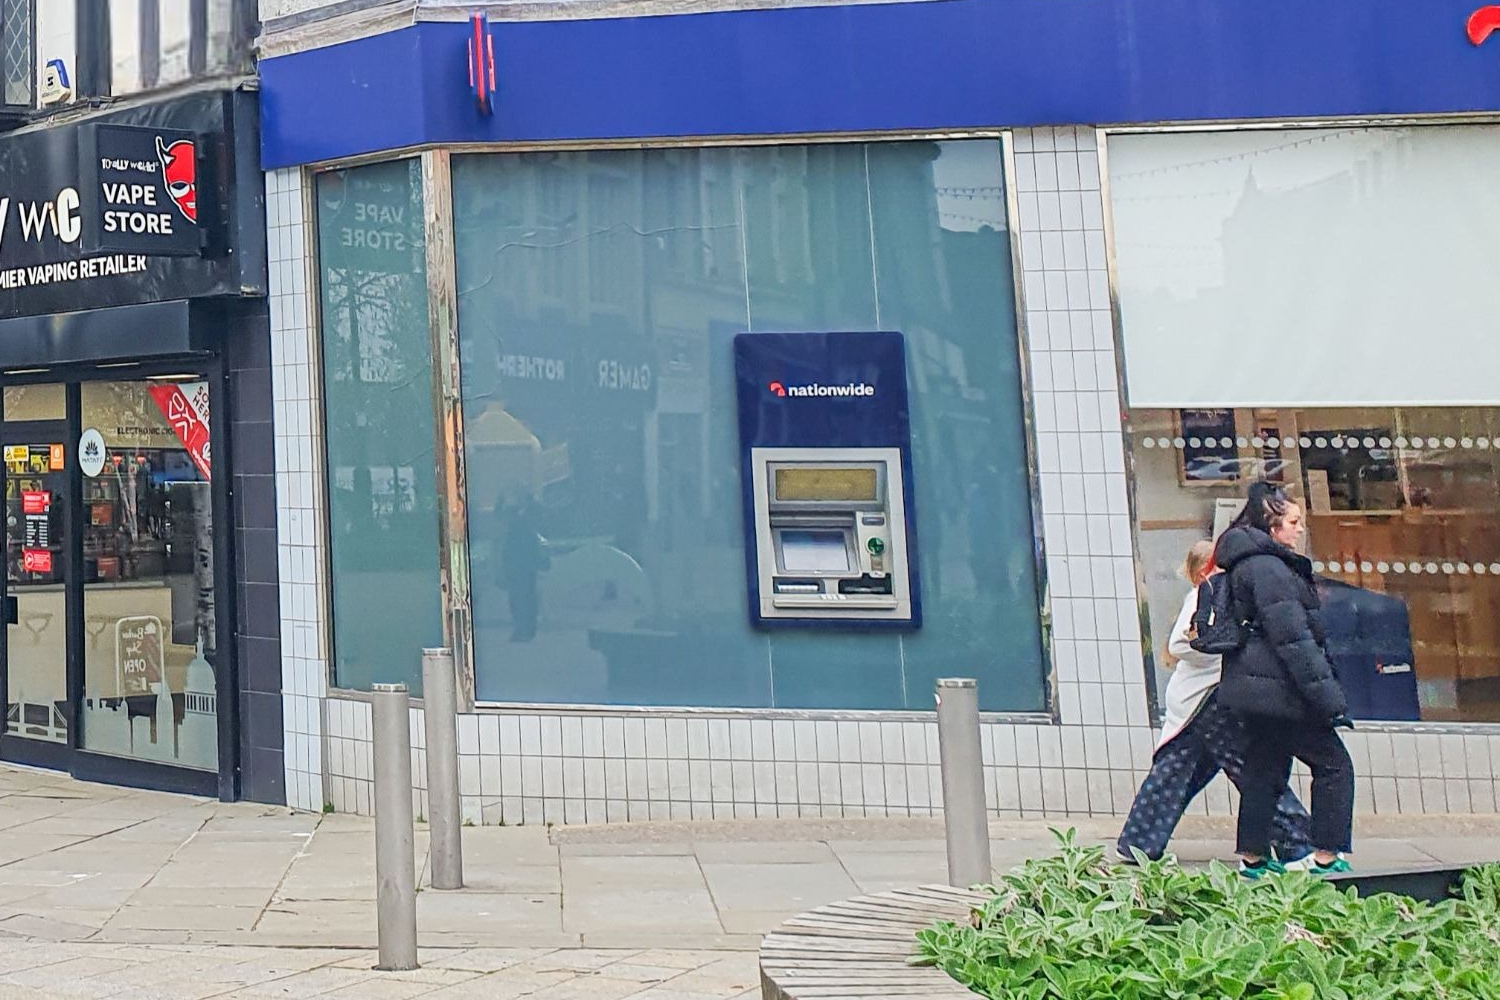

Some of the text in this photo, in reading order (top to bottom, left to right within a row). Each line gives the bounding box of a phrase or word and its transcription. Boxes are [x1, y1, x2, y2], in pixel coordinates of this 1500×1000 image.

[102, 183, 156, 206] VAPE
[104, 210, 173, 234] STORE
[27, 263, 77, 285] VAPING
[788, 383, 874, 396] nationwide
